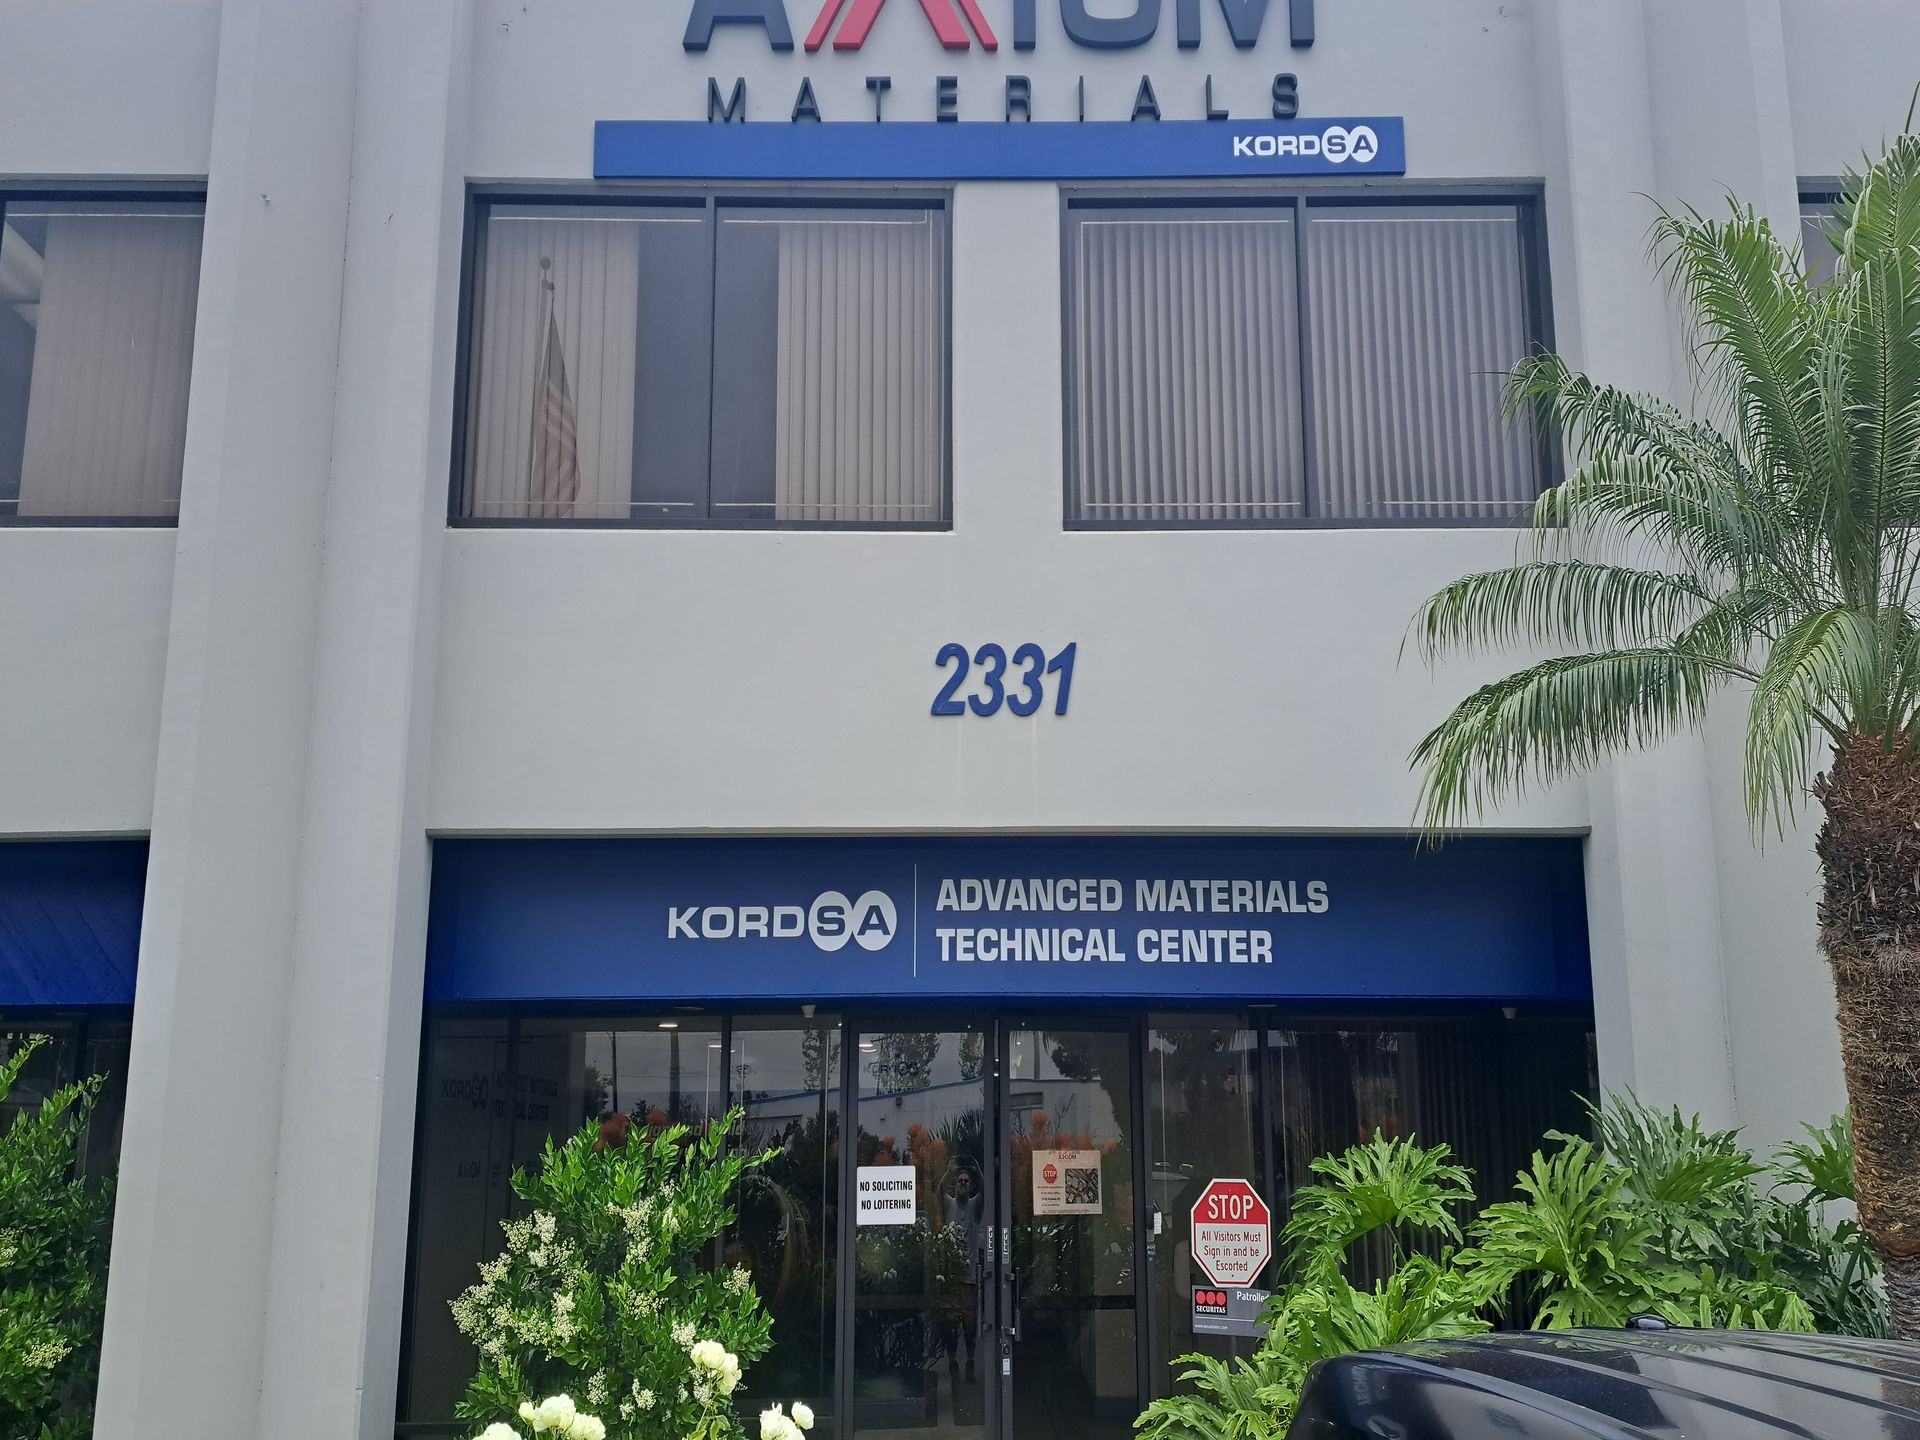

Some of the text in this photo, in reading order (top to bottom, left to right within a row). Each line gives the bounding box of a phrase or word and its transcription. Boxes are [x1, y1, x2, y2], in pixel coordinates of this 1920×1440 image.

[707, 72, 1300, 122] MATERIALS
[1233, 125, 1379, 164] KORDSA
[930, 641, 1077, 717] 2331
[936, 878, 1330, 913] ADVANCED MATERIALS
[667, 890, 897, 952] KORDSA
[936, 928, 1273, 963] TECHNICAL CENTER
[859, 1180, 913, 1192] NO SOLICITING
[861, 1199, 912, 1210] NO LOITERING
[1208, 1194, 1254, 1220] STOP
[1201, 1231, 1262, 1243] All Visitors Must
[1203, 1245, 1260, 1260] Sign in and be
[1215, 1260, 1248, 1272] Escorted
[1196, 1305, 1226, 1314] SECURITAS
